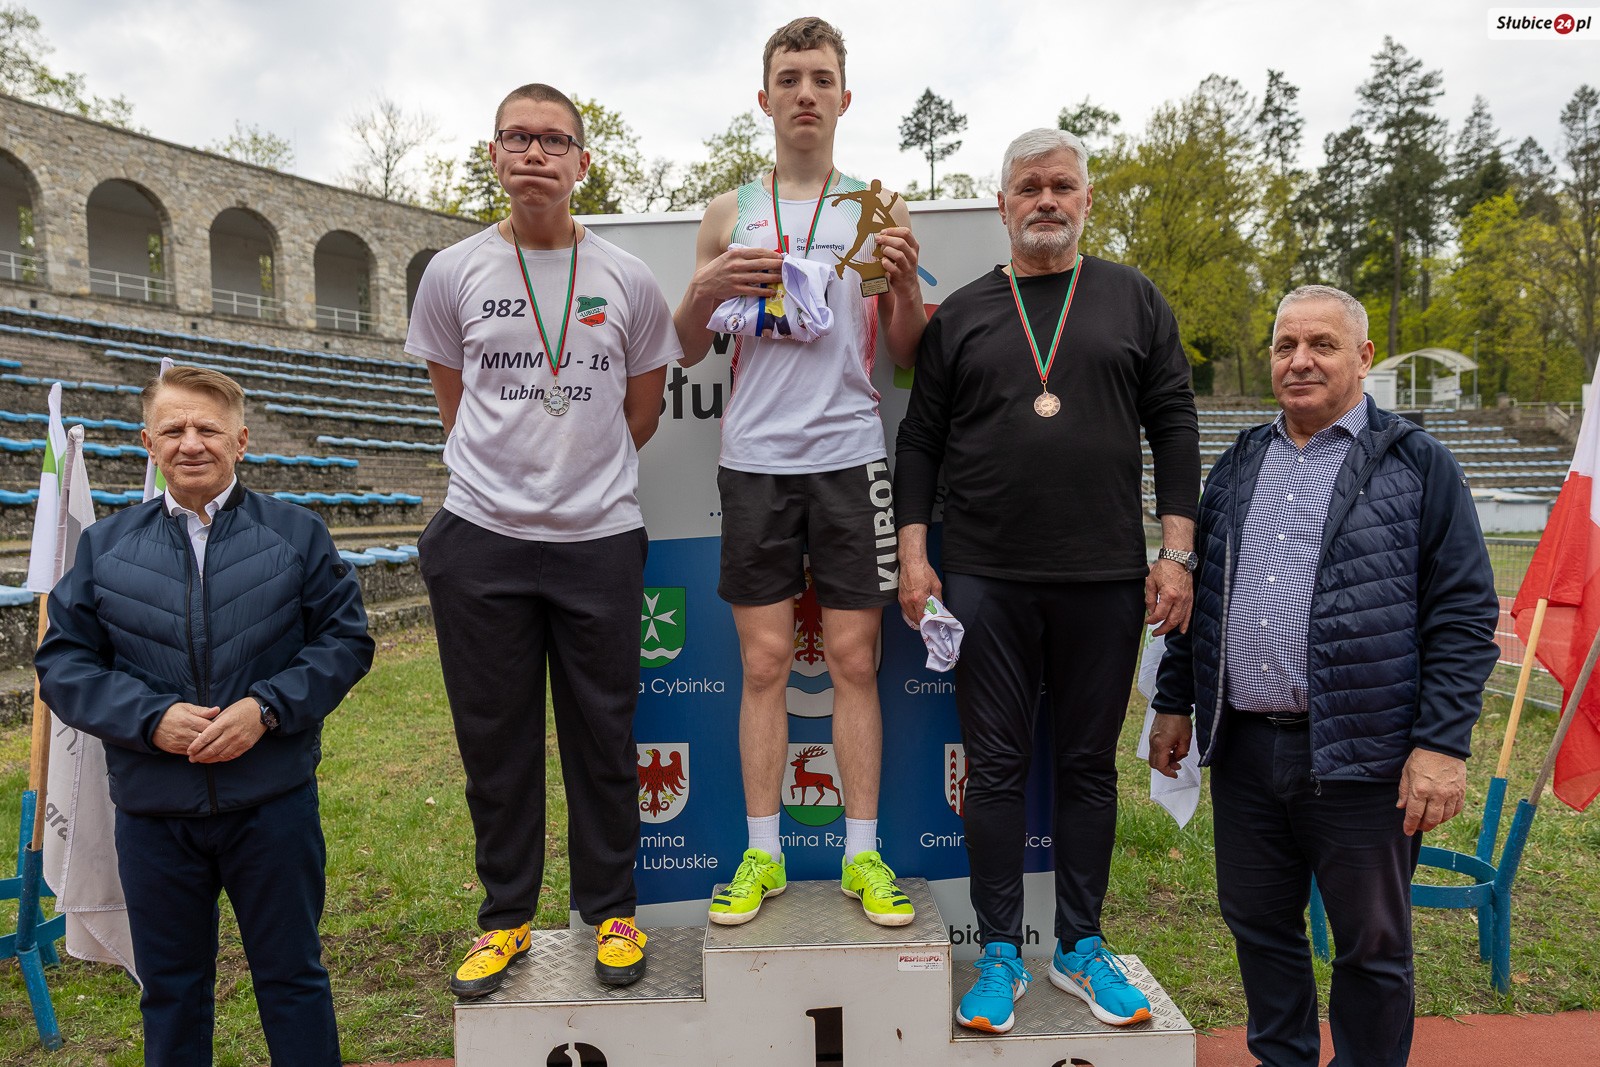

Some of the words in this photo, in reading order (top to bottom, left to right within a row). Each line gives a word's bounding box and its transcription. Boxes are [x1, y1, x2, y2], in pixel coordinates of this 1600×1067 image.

[815, 243, 845, 251] Inwestycji
[481, 298, 527, 319] 982
[481, 351, 544, 369] MMM
[589, 353, 610, 372] 16
[500, 384, 545, 401] Lubin
[650, 677, 725, 697] Cybinka
[904, 678, 956, 695] Gmin
[640, 832, 685, 848] mina
[779, 831, 819, 848] mina
[919, 831, 965, 848] Gmin
[643, 853, 719, 870] Lubuskie
[609, 920, 640, 942] NIKE
